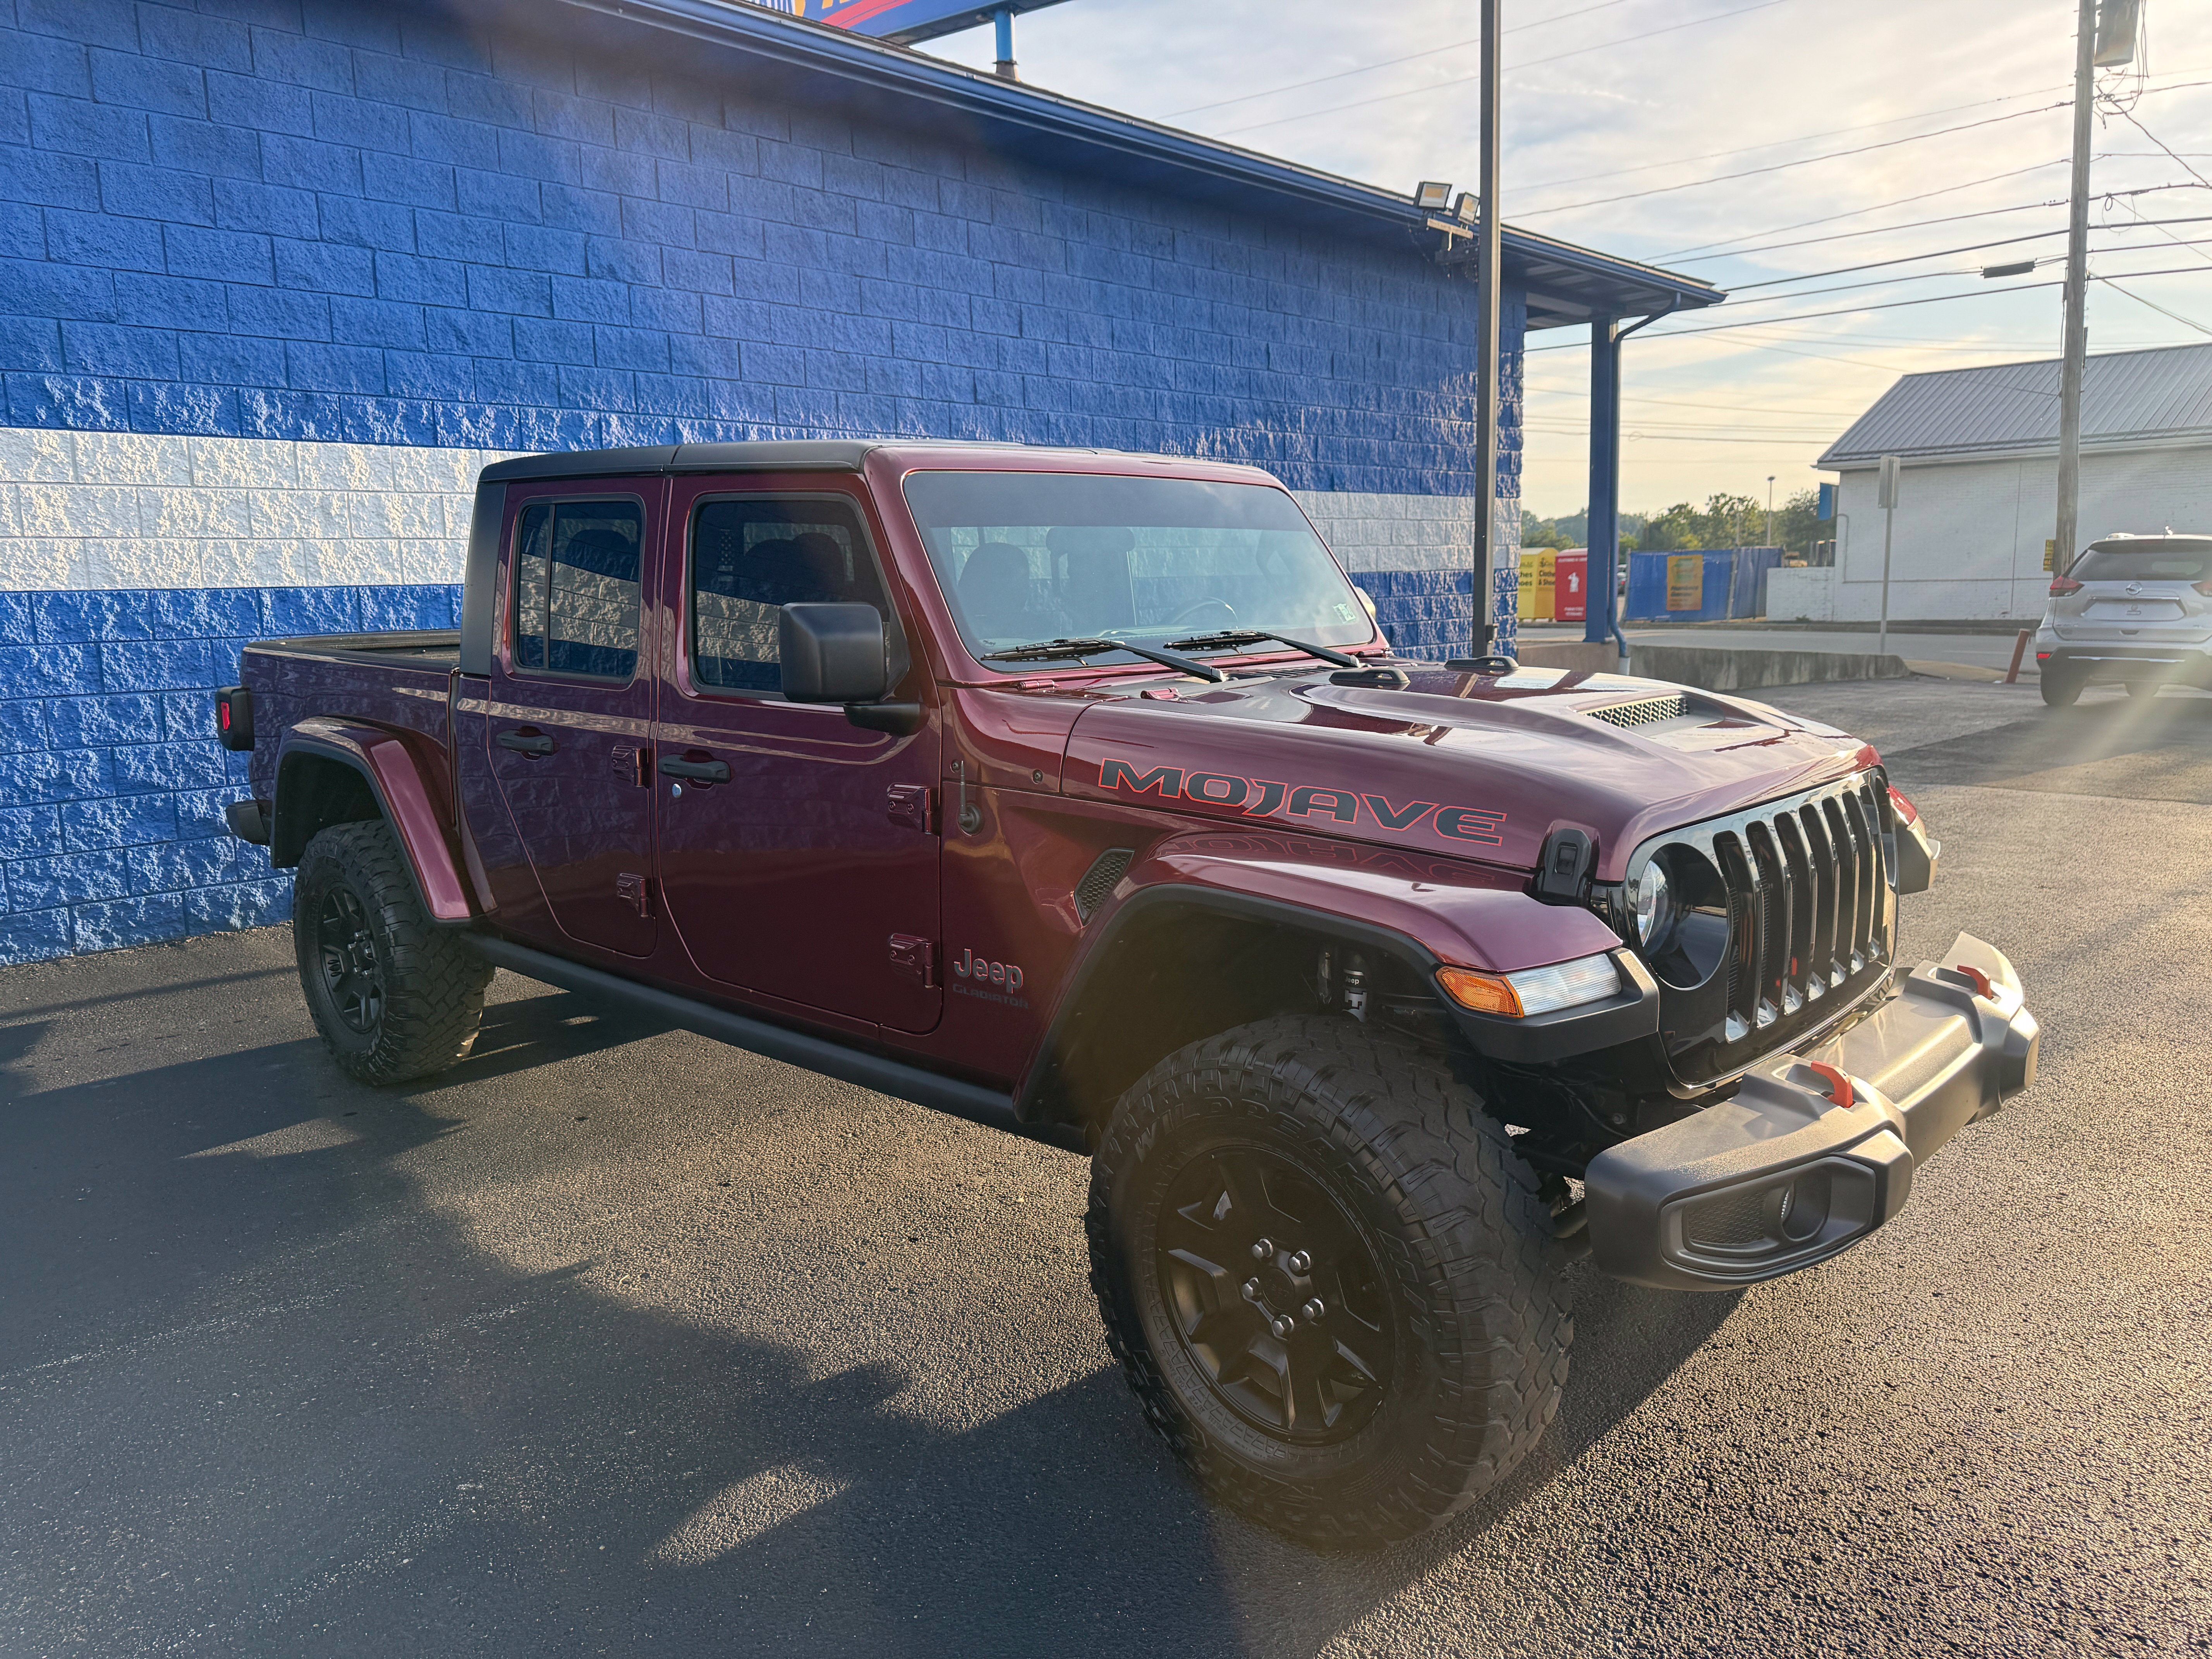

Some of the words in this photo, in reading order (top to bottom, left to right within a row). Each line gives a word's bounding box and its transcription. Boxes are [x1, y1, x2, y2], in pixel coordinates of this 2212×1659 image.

[1097, 757, 1508, 847] MOJAVE
[954, 948, 1024, 994] Jeep
[952, 983, 1029, 1010] GLADIATOR
